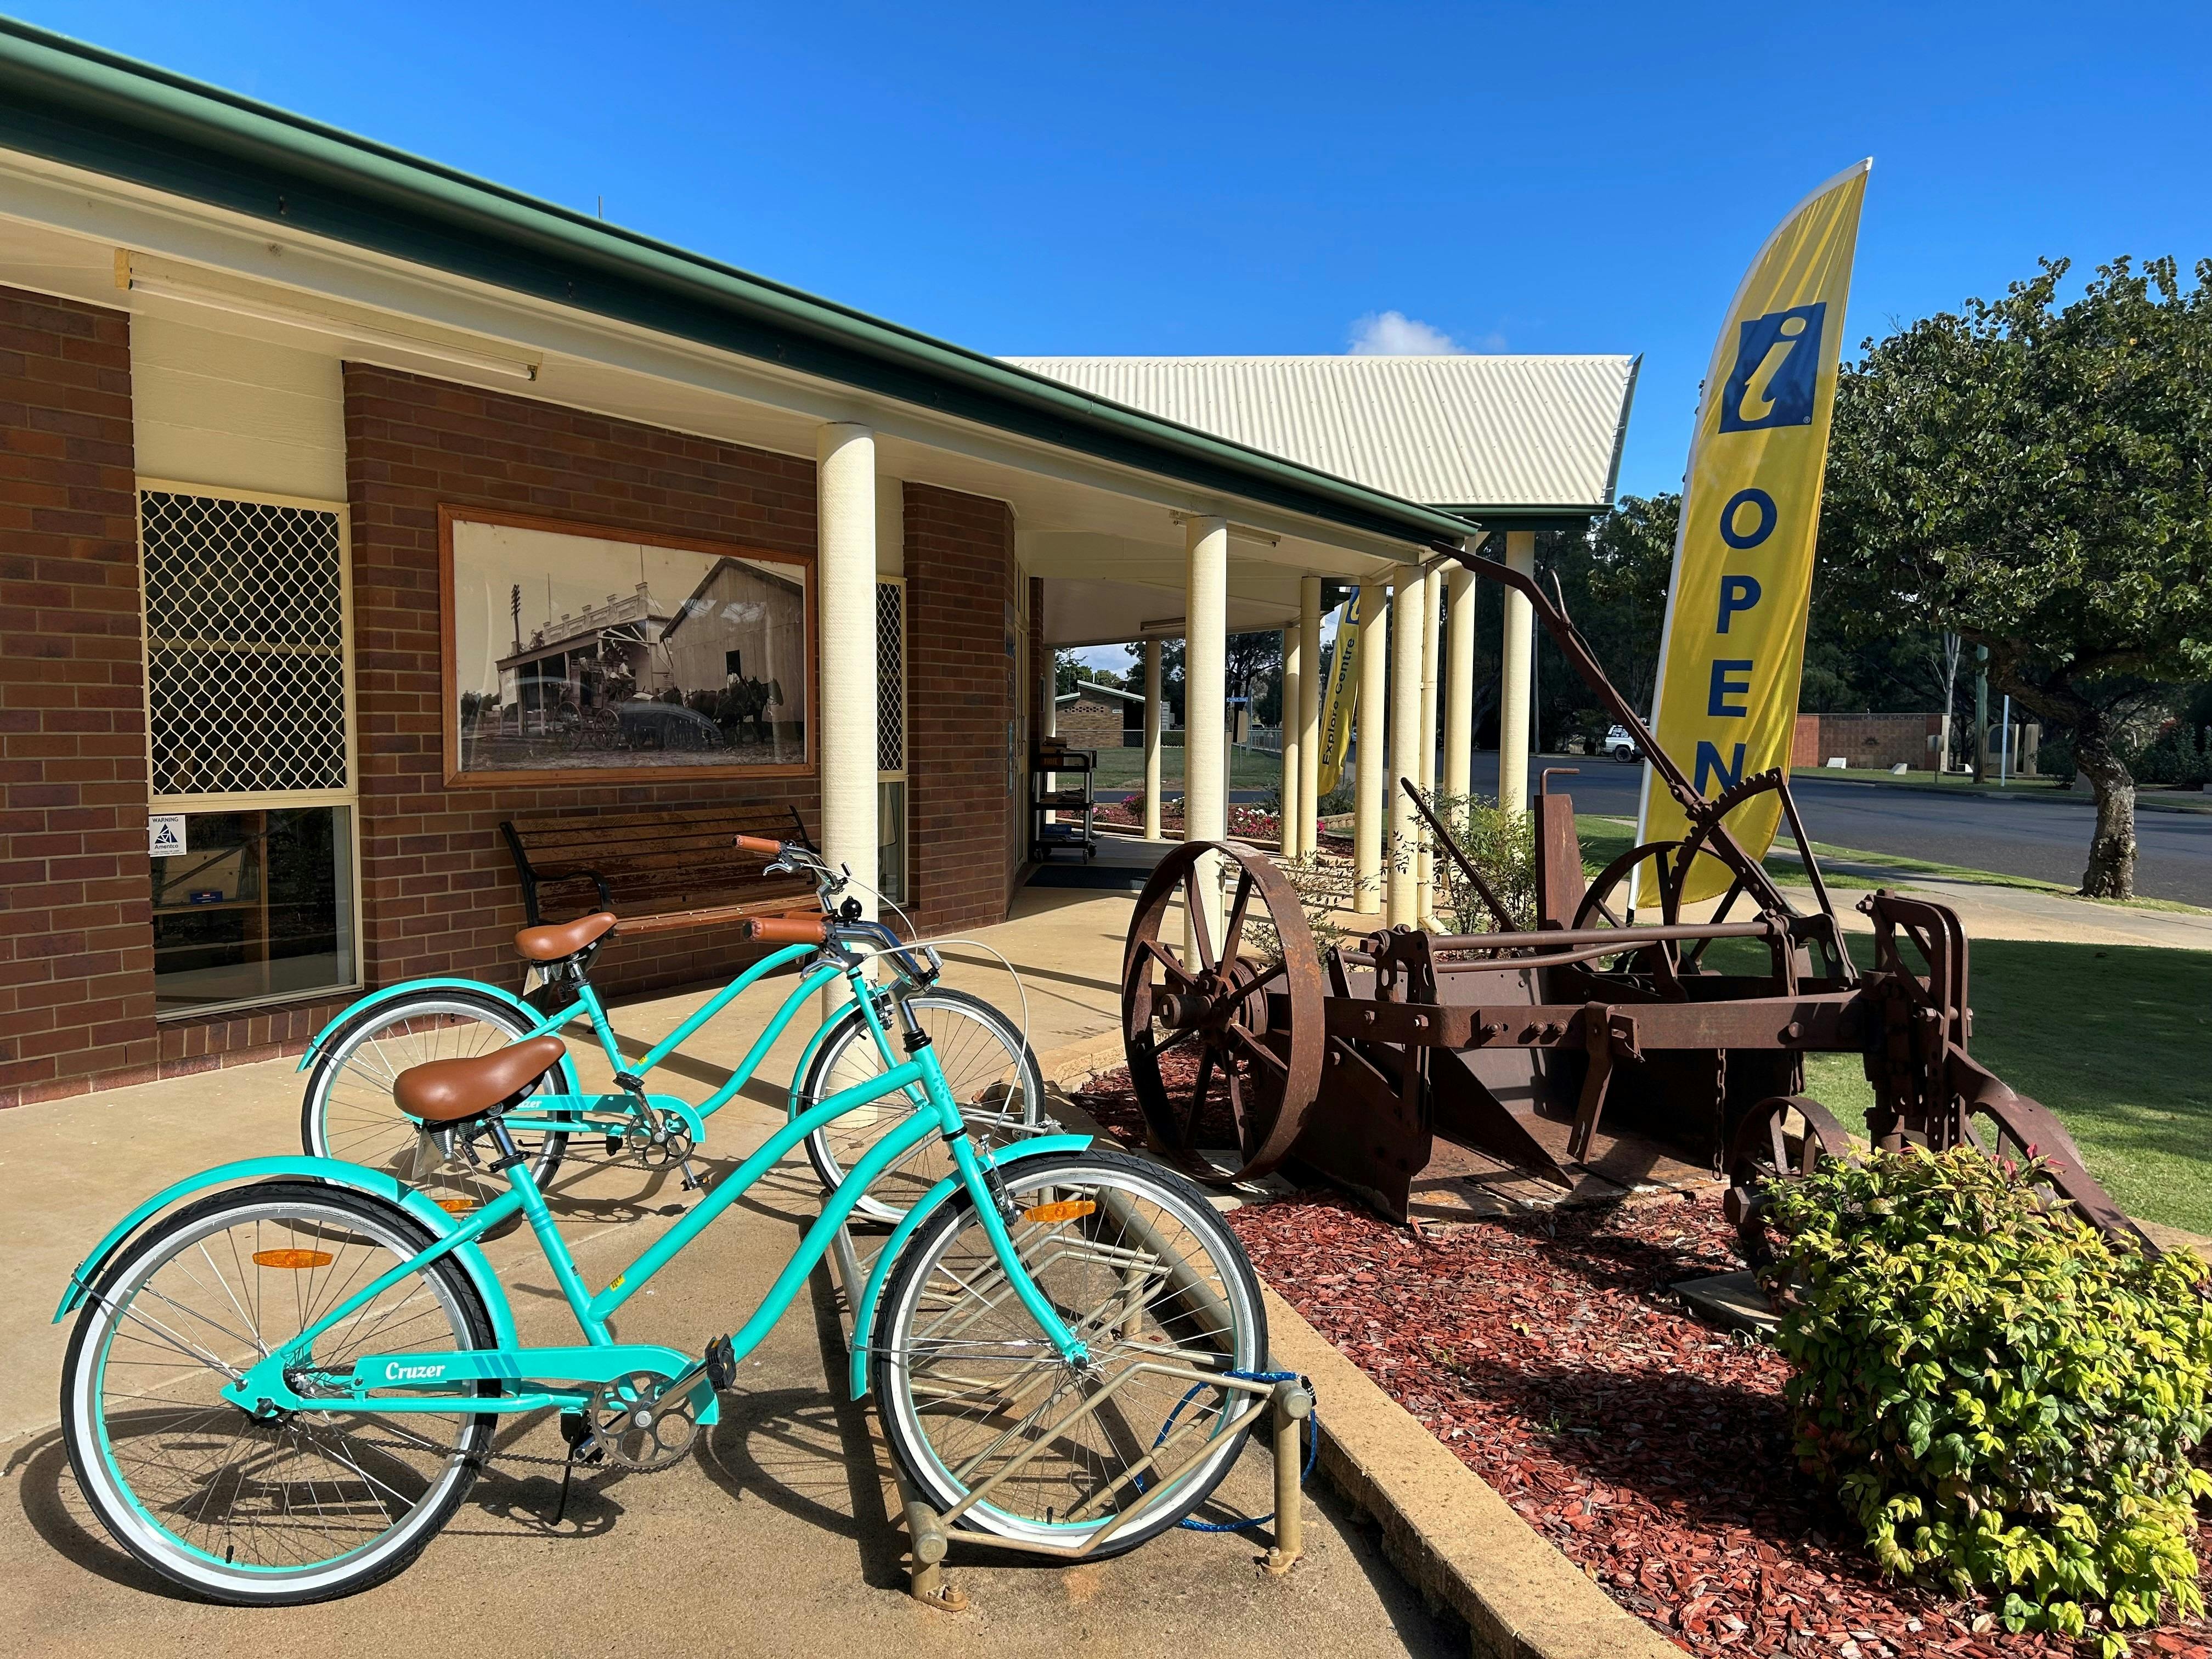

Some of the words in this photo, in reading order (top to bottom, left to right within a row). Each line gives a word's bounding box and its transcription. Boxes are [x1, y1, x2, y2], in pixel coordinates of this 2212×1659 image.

[1322, 700, 1339, 765] Explore
[1335, 638, 1355, 695] Centre
[1693, 488, 1778, 797] OPEN
[385, 1362, 446, 1380] Cruzer
